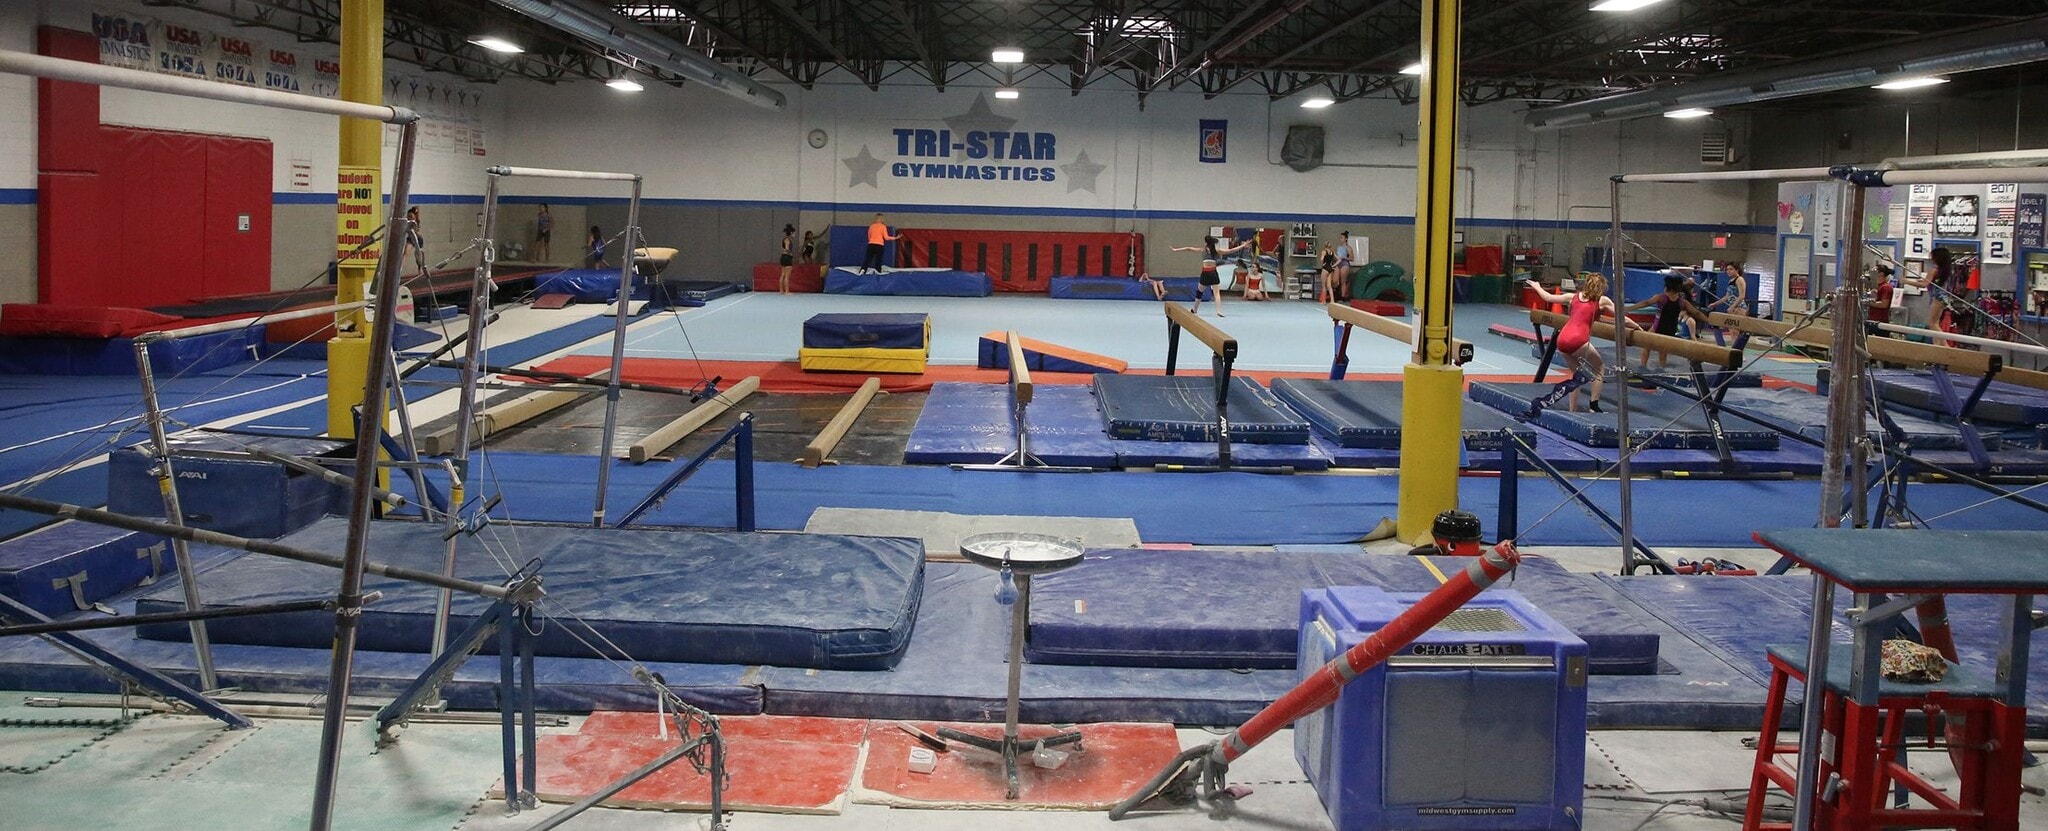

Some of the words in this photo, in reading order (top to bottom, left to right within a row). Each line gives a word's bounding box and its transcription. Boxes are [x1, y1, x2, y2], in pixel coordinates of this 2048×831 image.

[92, 12, 151, 47] USA
[166, 24, 202, 47] USA
[100, 40, 151, 62] MNASTICS
[220, 37, 253, 57] USA
[269, 48, 297, 66] USA
[314, 58, 341, 76] USA
[893, 128, 1057, 161] TRI-STAR
[338, 173, 373, 185] tudents
[892, 162, 1056, 182] GYMNASTICS
[1991, 183, 2015, 194] 2017
[338, 203, 372, 215] llowed
[346, 219, 359, 230] on
[1937, 215, 1978, 226] DIVISION
[1986, 231, 2009, 239] LEVEL
[1412, 643, 1464, 656] CHALK
[1418, 807, 1515, 815] midwestgymsupply.com
